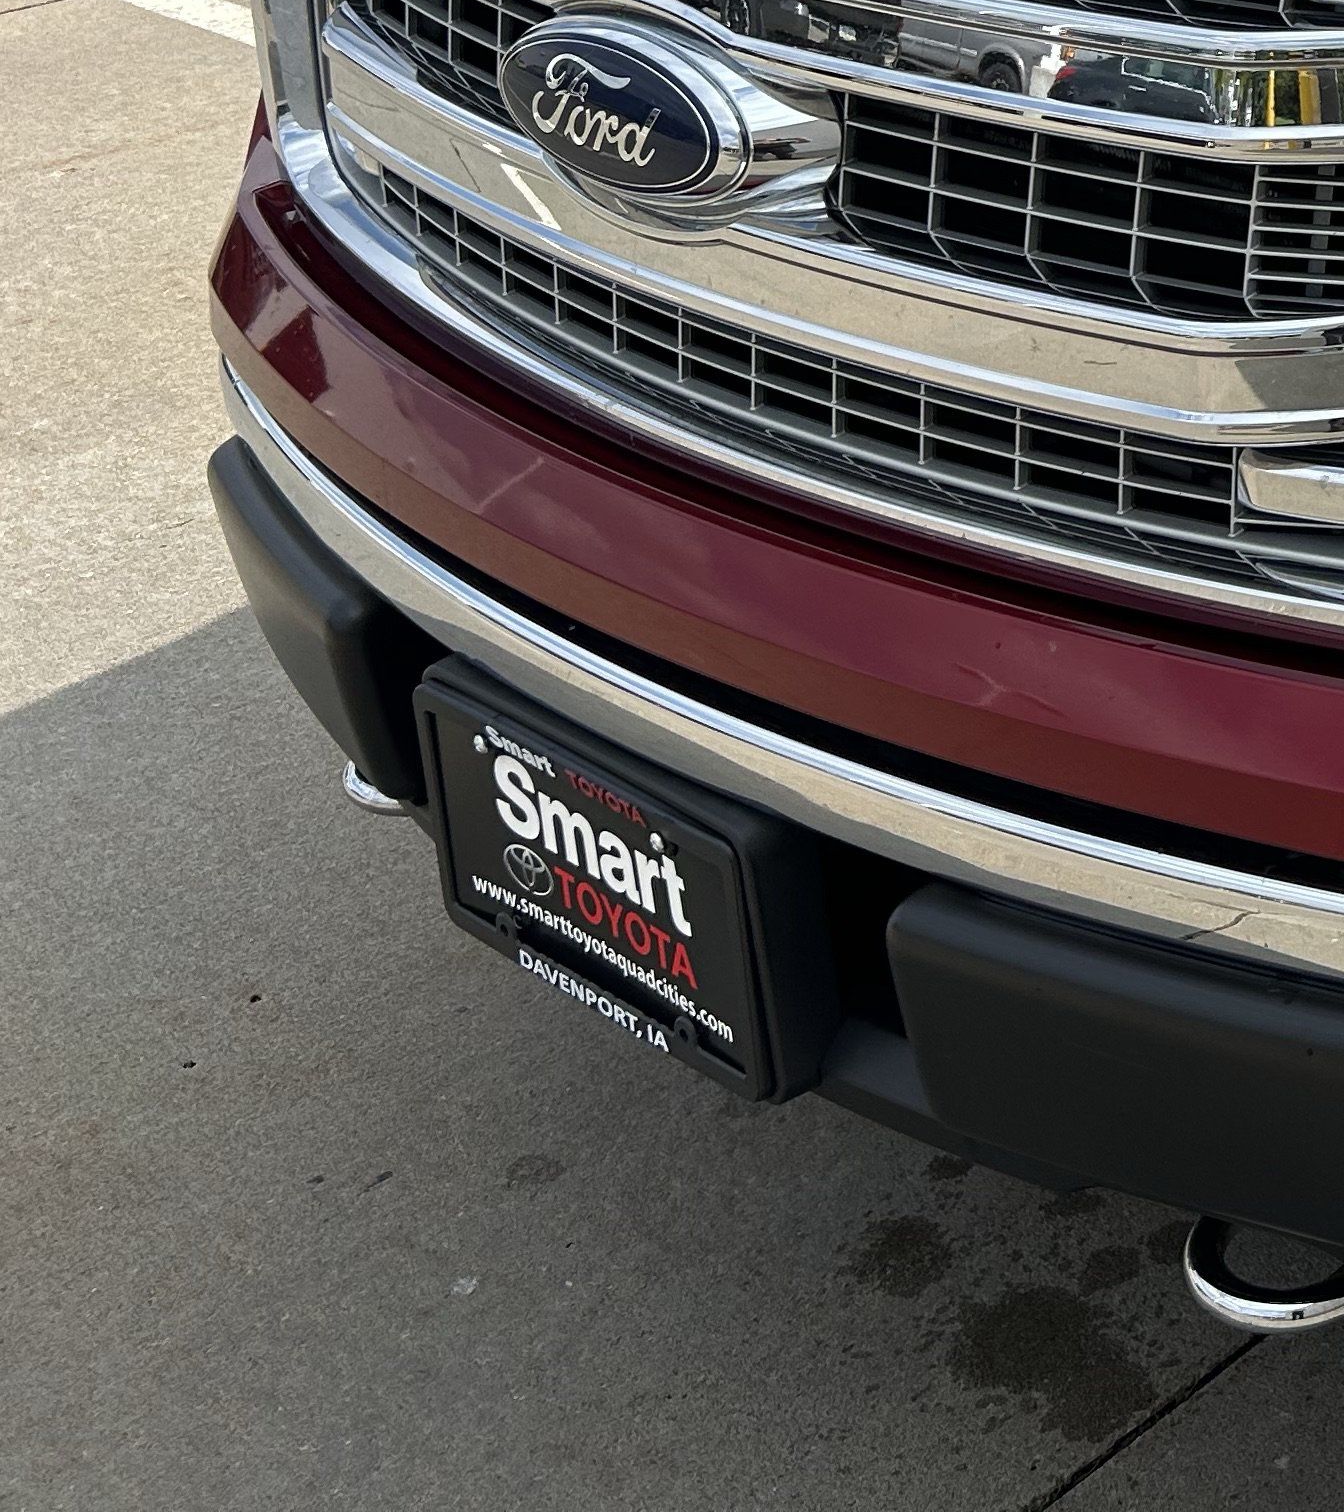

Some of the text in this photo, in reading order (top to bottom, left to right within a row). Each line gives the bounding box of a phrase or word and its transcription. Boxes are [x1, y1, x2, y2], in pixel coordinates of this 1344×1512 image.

[532, 52, 663, 167] Ford
[485, 724, 648, 829] Smart TOYOTA
[493, 754, 693, 937] Smart
[472, 873, 735, 1044] www.smarttoyotaquadcities.com
[553, 866, 698, 989] TOYOTA
[518, 948, 670, 1053] DAVENPORT, IA
